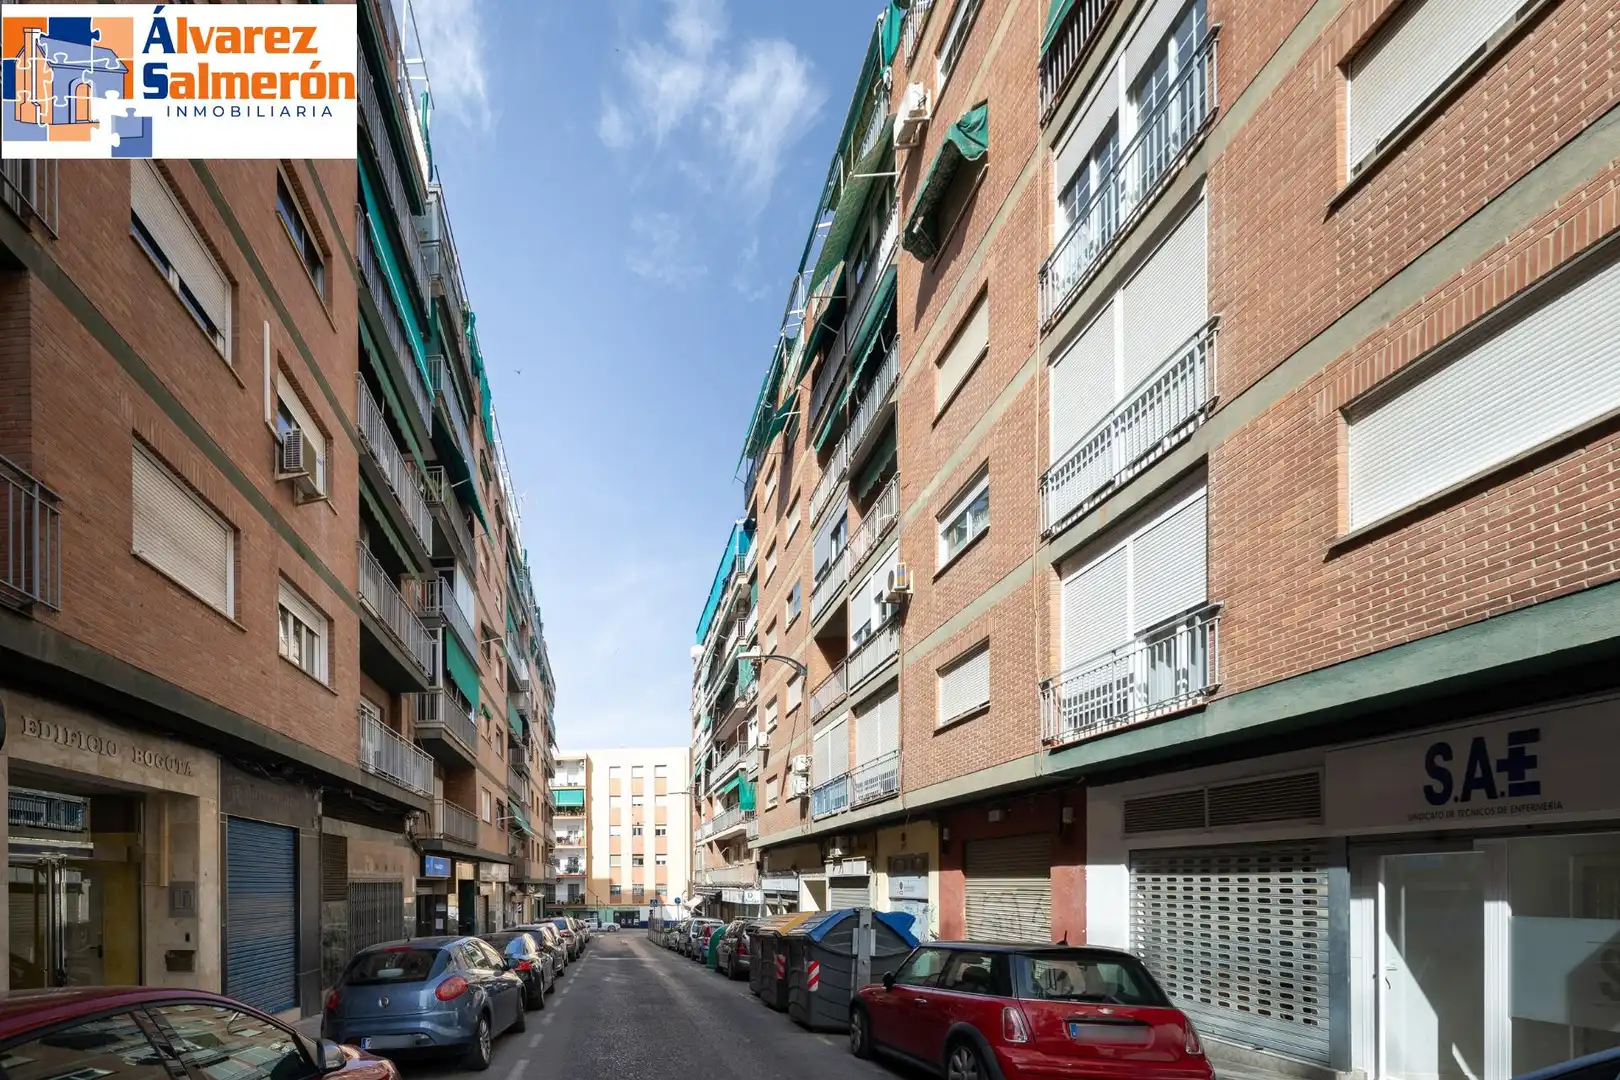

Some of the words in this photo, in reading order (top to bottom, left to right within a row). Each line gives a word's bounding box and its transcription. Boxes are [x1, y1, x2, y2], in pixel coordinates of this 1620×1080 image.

[21, 715, 118, 758] EDIFICIO
[131, 744, 195, 777] BOGOTA
[1407, 810, 1444, 822] SINDICATO
[1446, 809, 1455, 819] DE
[1497, 805, 1508, 815] DE
